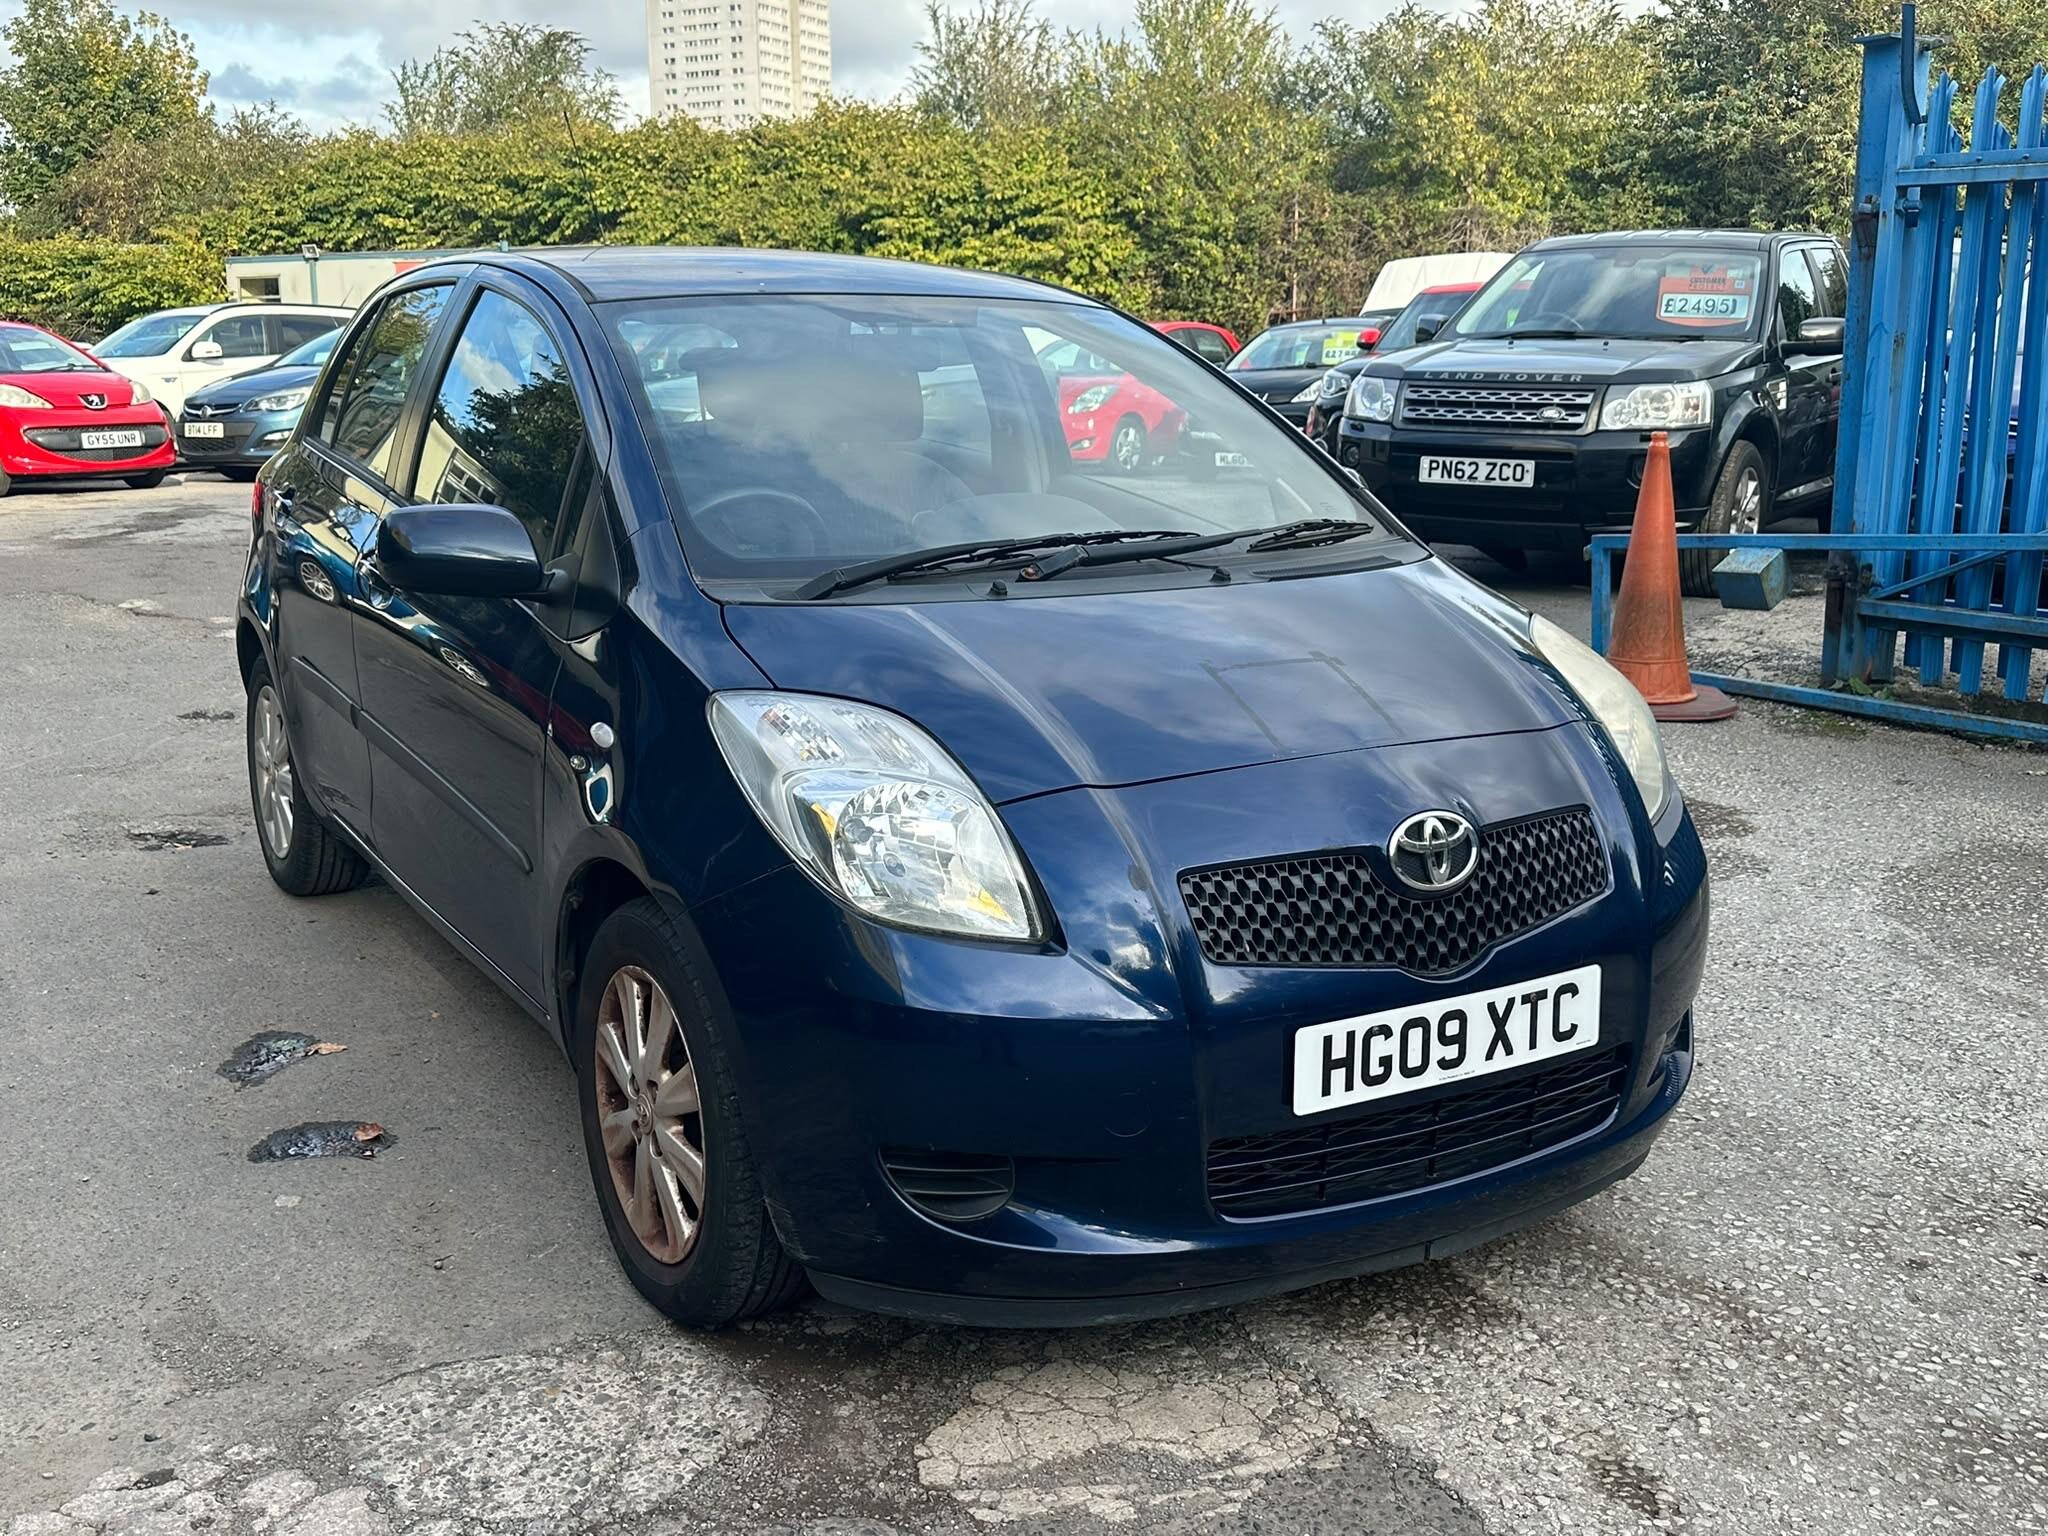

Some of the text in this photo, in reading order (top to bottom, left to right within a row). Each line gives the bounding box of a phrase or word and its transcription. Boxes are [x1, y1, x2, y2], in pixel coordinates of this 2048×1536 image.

[1423, 371, 1583, 382] LAND ROVER
[188, 424, 218, 436] BT14 LFF
[87, 432, 137, 446] GY55 UNR
[1428, 459, 1525, 482] PN62 ZCO
[1321, 982, 1580, 1098] HG09 XTC
